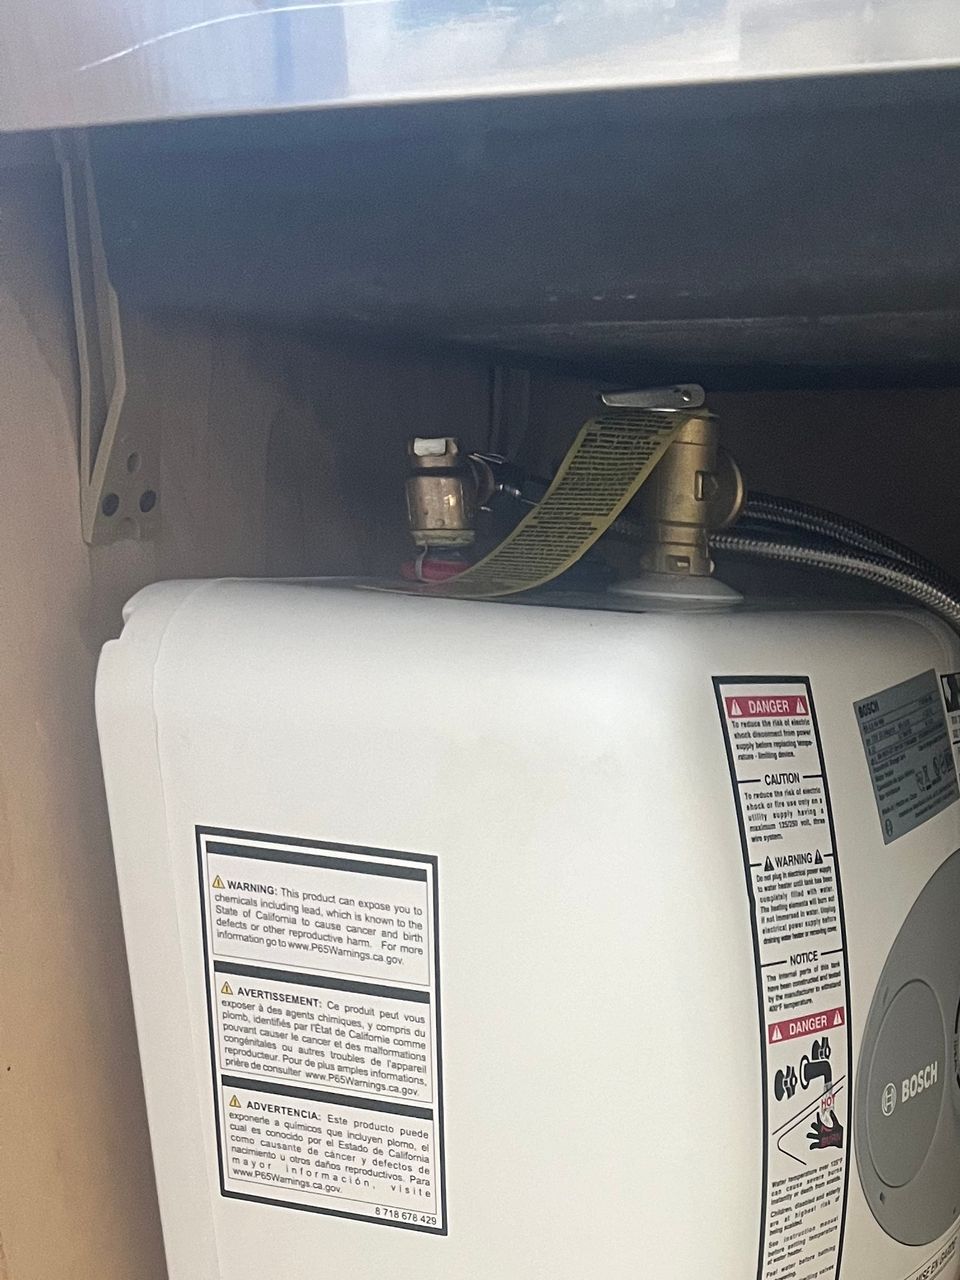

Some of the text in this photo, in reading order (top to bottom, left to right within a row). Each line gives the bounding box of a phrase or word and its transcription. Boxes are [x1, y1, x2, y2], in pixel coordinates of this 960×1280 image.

[748, 700, 790, 714] DANGER
[858, 700, 880, 719] BOSCH
[764, 773, 800, 786] CAUTION
[774, 852, 813, 868] WARNING
[215, 893, 258, 907] chemicals
[260, 899, 299, 915] including
[326, 909, 352, 920] which
[355, 912, 362, 921] is
[365, 914, 394, 926] known
[397, 919, 405, 928] to
[408, 920, 422, 930] the
[227, 880, 422, 916] WARNING: This product can expose you to
[216, 905, 423, 943] State of California to cause cancer and birth
[216, 918, 247, 930] defects
[263, 925, 285, 935] other
[289, 930, 343, 944] reproductive
[381, 941, 397, 951] For
[400, 946, 423, 955] more
[217, 929, 264, 944] information
[266, 938, 277, 947] go
[278, 939, 286, 948] to
[789, 950, 818, 966] NOTICE
[221, 1000, 425, 1038] exposer à des agents chimiques, y compris du
[238, 987, 425, 1024] AVERTISSEMENT: Ce produit peut vous
[222, 1010, 426, 1050] plomb, identifiés par l'État de Californie comme
[223, 1023, 257, 1035] pouvant
[259, 1029, 288, 1040] causer
[291, 1033, 299, 1041] le
[302, 1036, 331, 1046] cancer
[345, 1042, 361, 1051] des
[364, 1046, 426, 1062] malformations
[789, 1015, 828, 1036] DANGER
[224, 1035, 277, 1050] congénitales
[298, 1047, 325, 1058] autres
[330, 1051, 365, 1064] troubles
[371, 1058, 381, 1066] de
[387, 1060, 427, 1074] l'appareil
[224, 1047, 280, 1061] reproducteur.
[282, 1054, 303, 1065] Pour
[304, 1059, 315, 1068] de
[317, 1061, 335, 1071] plus
[337, 1065, 368, 1076] amples
[225, 1058, 249, 1068] prière
[251, 1062, 261, 1070] de
[263, 1064, 302, 1076] consulter
[901, 1060, 938, 1103] BOSCH
[246, 1101, 428, 1139] ADVERTENCIA: Este producto puede
[821, 1094, 836, 1109] HOT
[230, 1124, 430, 1164] cual es conocido por el Estado de California
[230, 1135, 255, 1145] como
[260, 1140, 301, 1153] causante
[307, 1147, 319, 1156] de
[361, 1158, 366, 1166] y
[372, 1158, 412, 1172] defectos
[418, 1166, 430, 1175] de
[284, 1121, 322, 1134] químicos
[326, 1129, 342, 1138] que
[347, 1131, 383, 1144] incluyen
[422, 1144, 429, 1152] el
[231, 1146, 276, 1160] nacimiento
[289, 1156, 310, 1166] otros
[315, 1160, 341, 1171] daños
[345, 1166, 405, 1182] reproductivos.
[410, 1175, 430, 1186] Para
[232, 1157, 271, 1169] mayor
[391, 1185, 431, 1198] visite
[375, 1207, 436, 1225] 8 718 678 429
